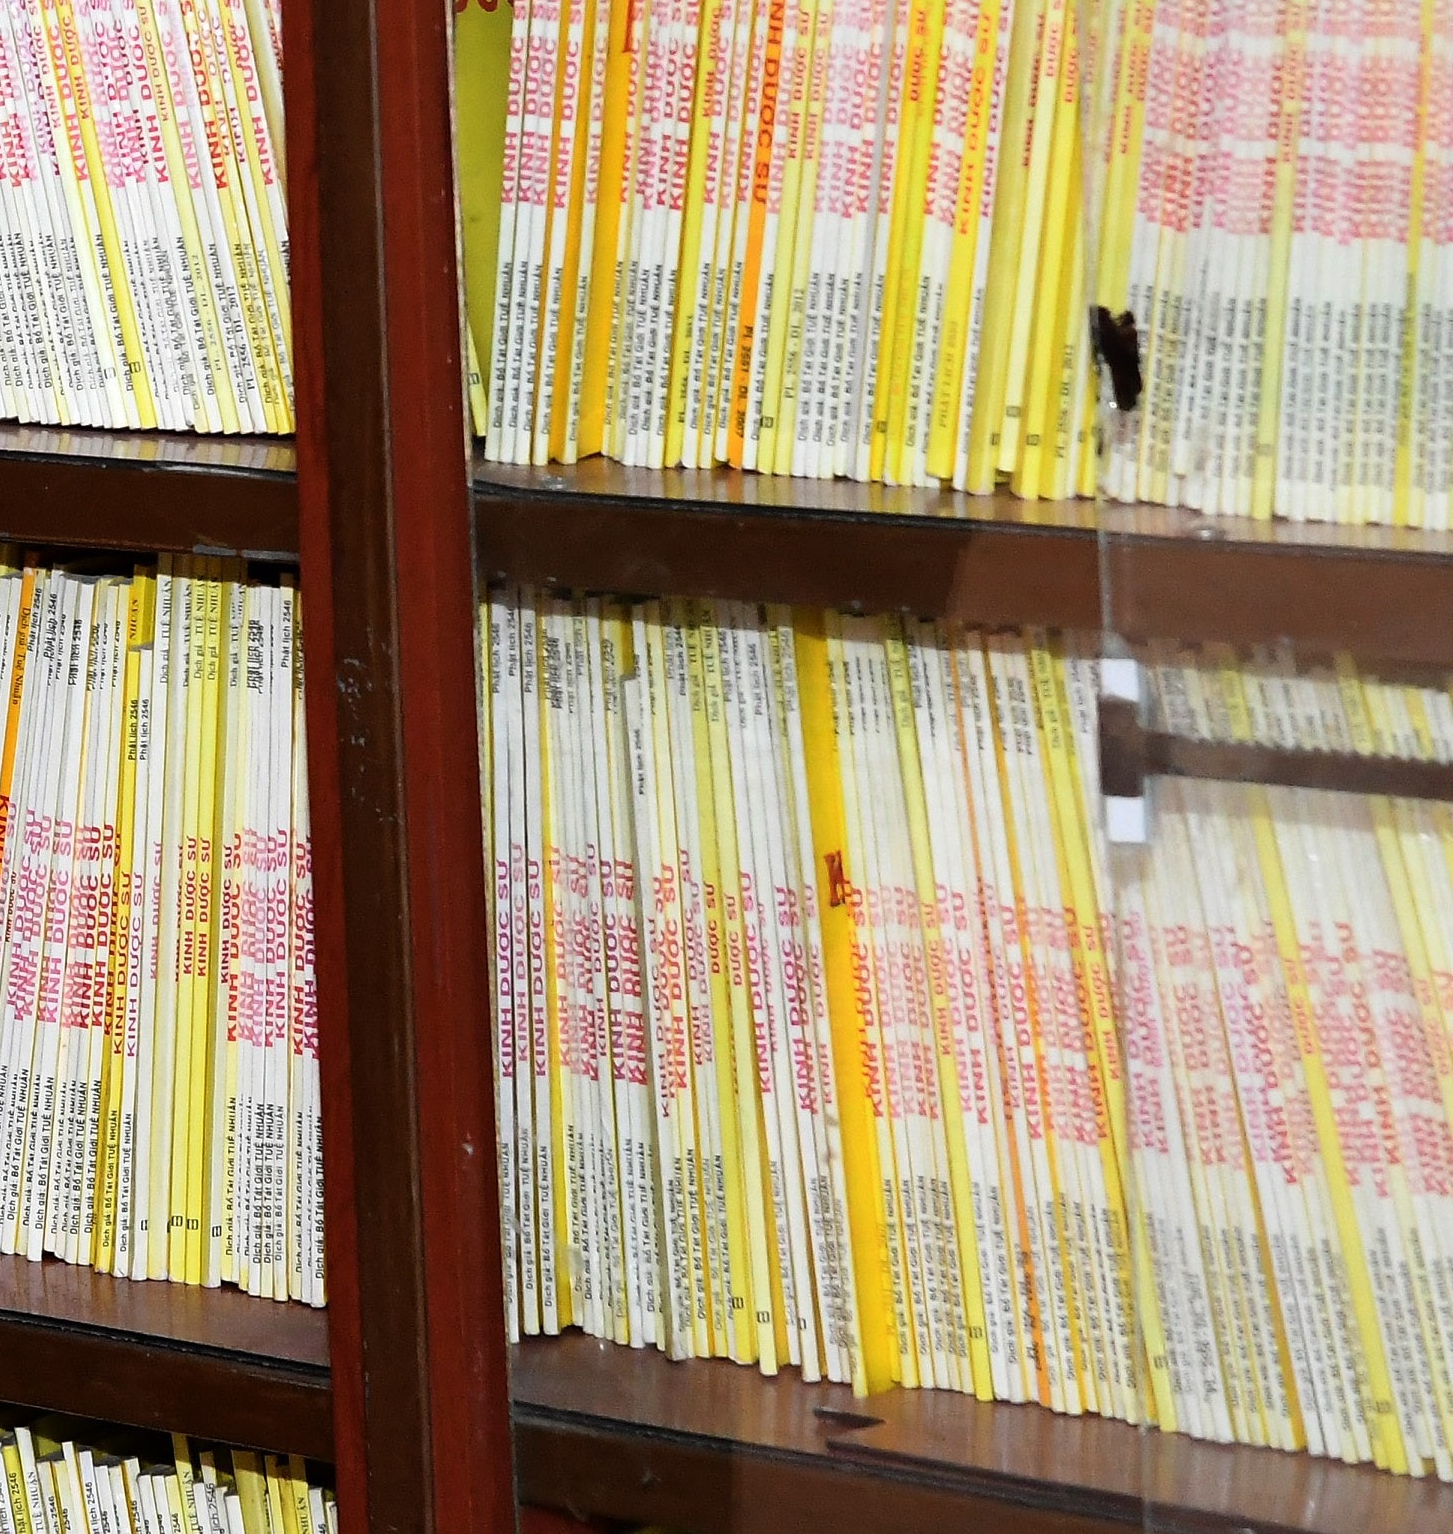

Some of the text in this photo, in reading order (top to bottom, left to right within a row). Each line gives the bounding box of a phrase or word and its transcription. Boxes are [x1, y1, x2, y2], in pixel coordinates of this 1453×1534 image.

[73, 76, 89, 120] KINH
[141, 698, 149, 718] 2546
[183, 930, 193, 974] KINH
[197, 933, 207, 976] KINH
[221, 940, 229, 984] KINH
[113, 996, 125, 1054] KINH
[127, 998, 137, 1057] KINH
[501, 1008, 513, 1078] KINH
